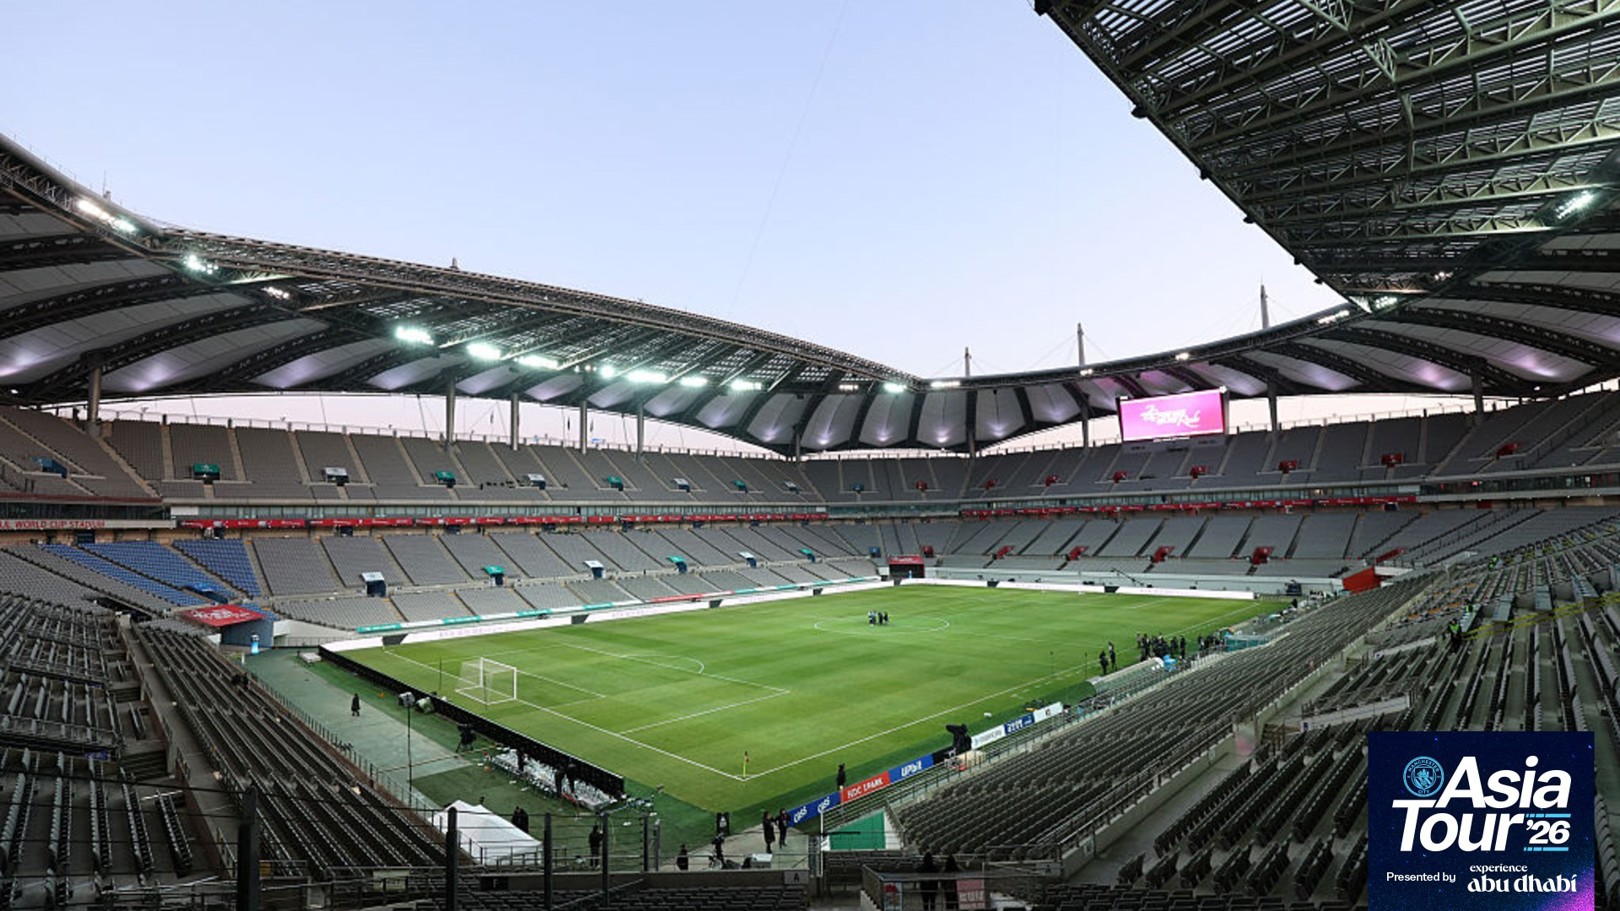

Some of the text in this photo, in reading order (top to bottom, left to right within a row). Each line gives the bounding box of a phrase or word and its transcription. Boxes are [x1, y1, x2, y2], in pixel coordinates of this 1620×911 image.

[15, 520, 46, 529] WORLD
[50, 520, 67, 529] CUP
[69, 520, 105, 529] STADIUM
